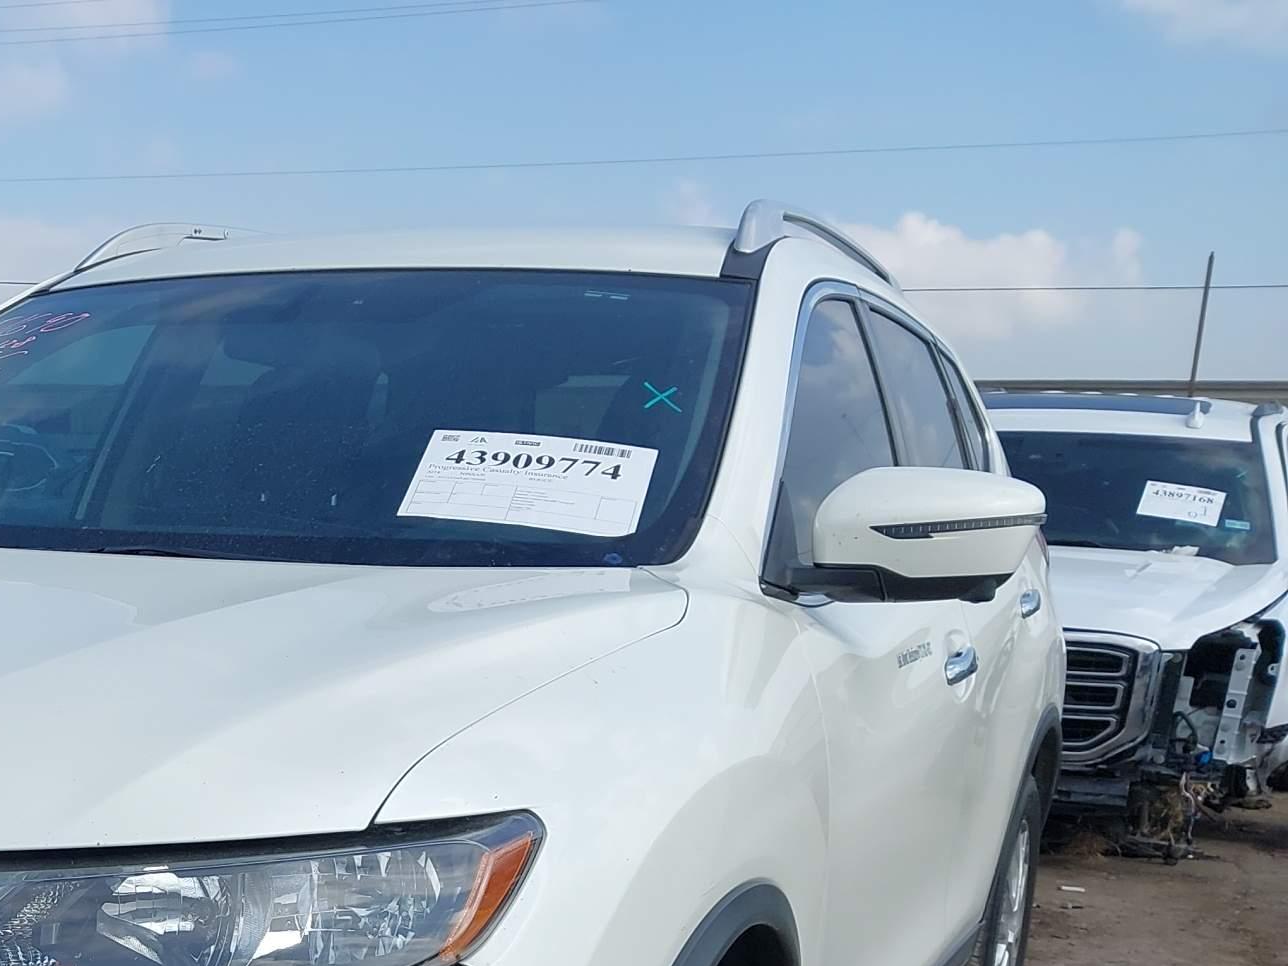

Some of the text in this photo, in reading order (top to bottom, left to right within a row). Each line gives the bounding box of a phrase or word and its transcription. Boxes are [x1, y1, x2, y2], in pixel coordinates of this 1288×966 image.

[428, 463, 481, 472] Progressive
[524, 470, 569, 480] Insurance
[445, 448, 622, 480] 43909774
[1152, 488, 1214, 504] 43897168
